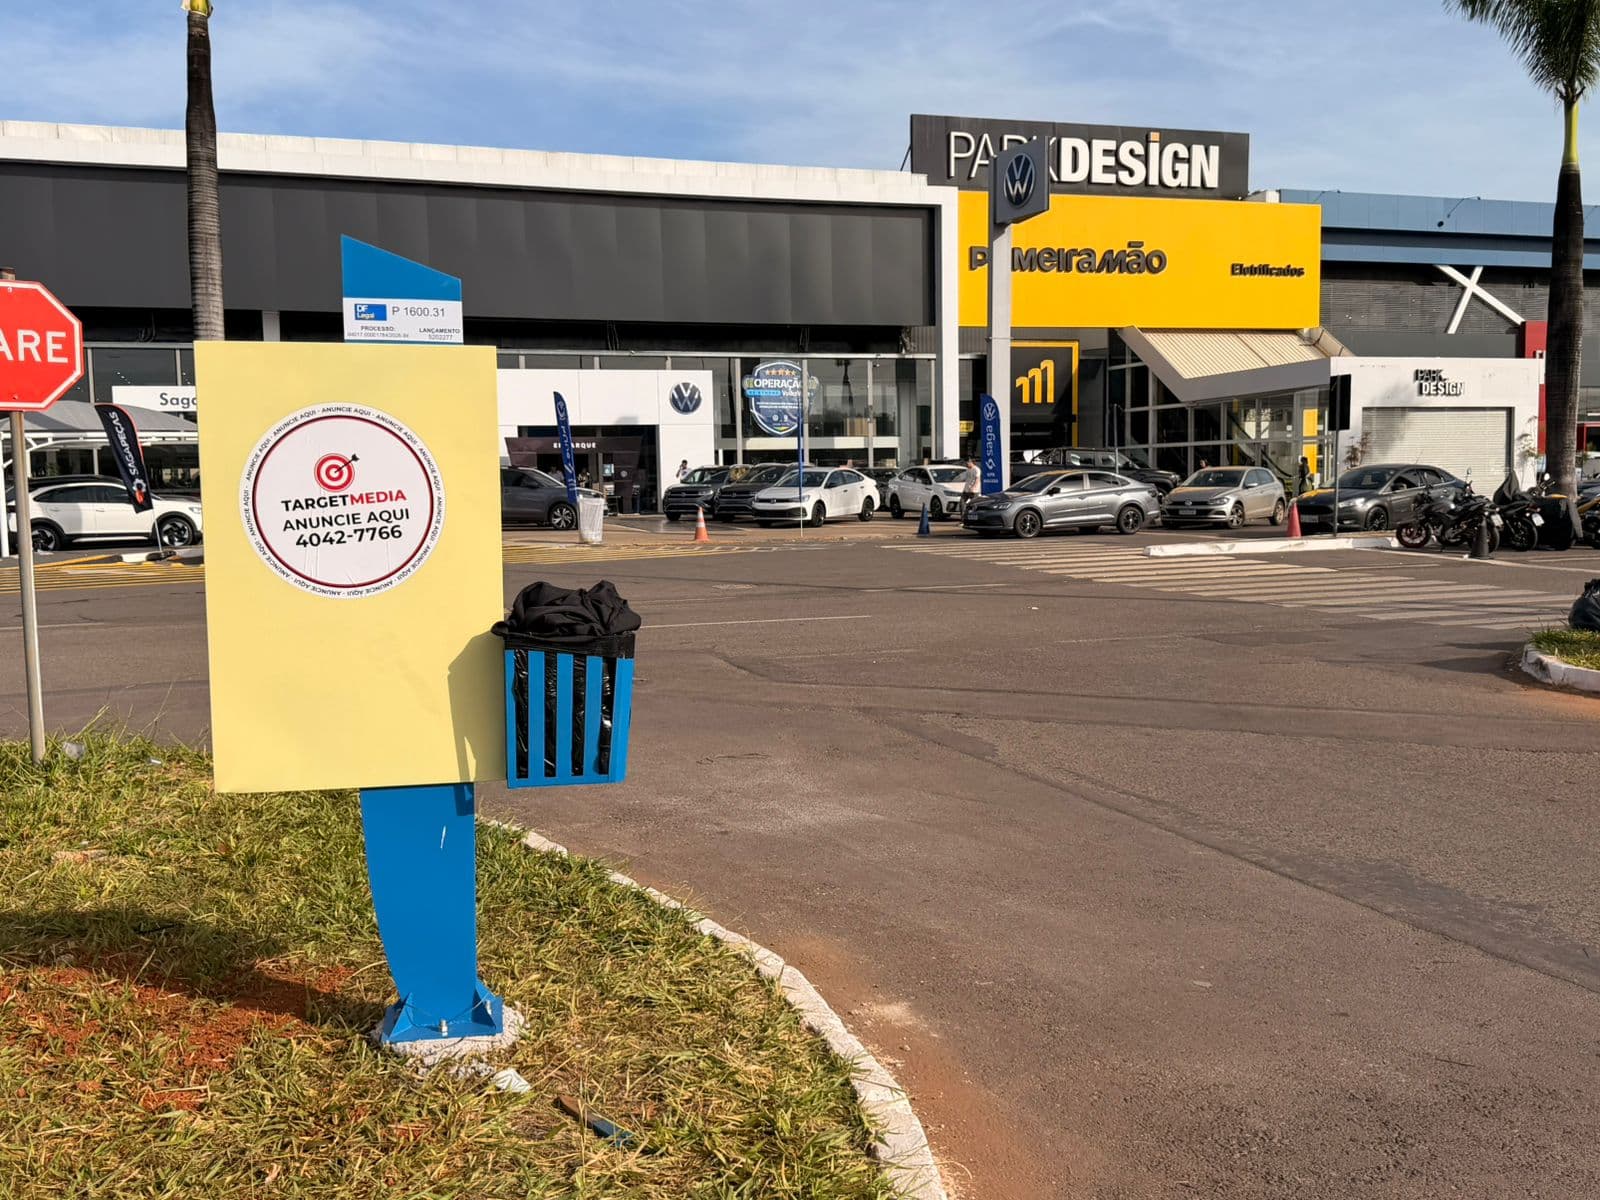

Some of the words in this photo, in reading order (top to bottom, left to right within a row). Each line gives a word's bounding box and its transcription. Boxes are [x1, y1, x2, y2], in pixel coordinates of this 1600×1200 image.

[356, 304, 368, 312] DF
[356, 312, 375, 320] Legal
[392, 306, 400, 316] P
[405, 307, 445, 317] 1600.31
[754, 377, 801, 391] OPERAÇÃ
[1414, 369, 1446, 382] PARK
[1418, 382, 1464, 396] DESIGN
[354, 408, 371, 416] AQUI
[272, 416, 299, 436] ANUNCIE
[300, 410, 317, 419] AQUI
[376, 414, 403, 432] ANUNCIE
[403, 431, 418, 445] AQUI
[246, 453, 260, 480] ANUNCIE
[258, 438, 272, 454] AQUI
[418, 448, 437, 474] ANUNCIE
[433, 475, 441, 491] AQUI
[281, 489, 407, 512] TARGETMEDIA
[283, 513, 362, 532] ANUNCIE
[367, 508, 410, 523] AQUI
[296, 525, 403, 548] 4042-7766
